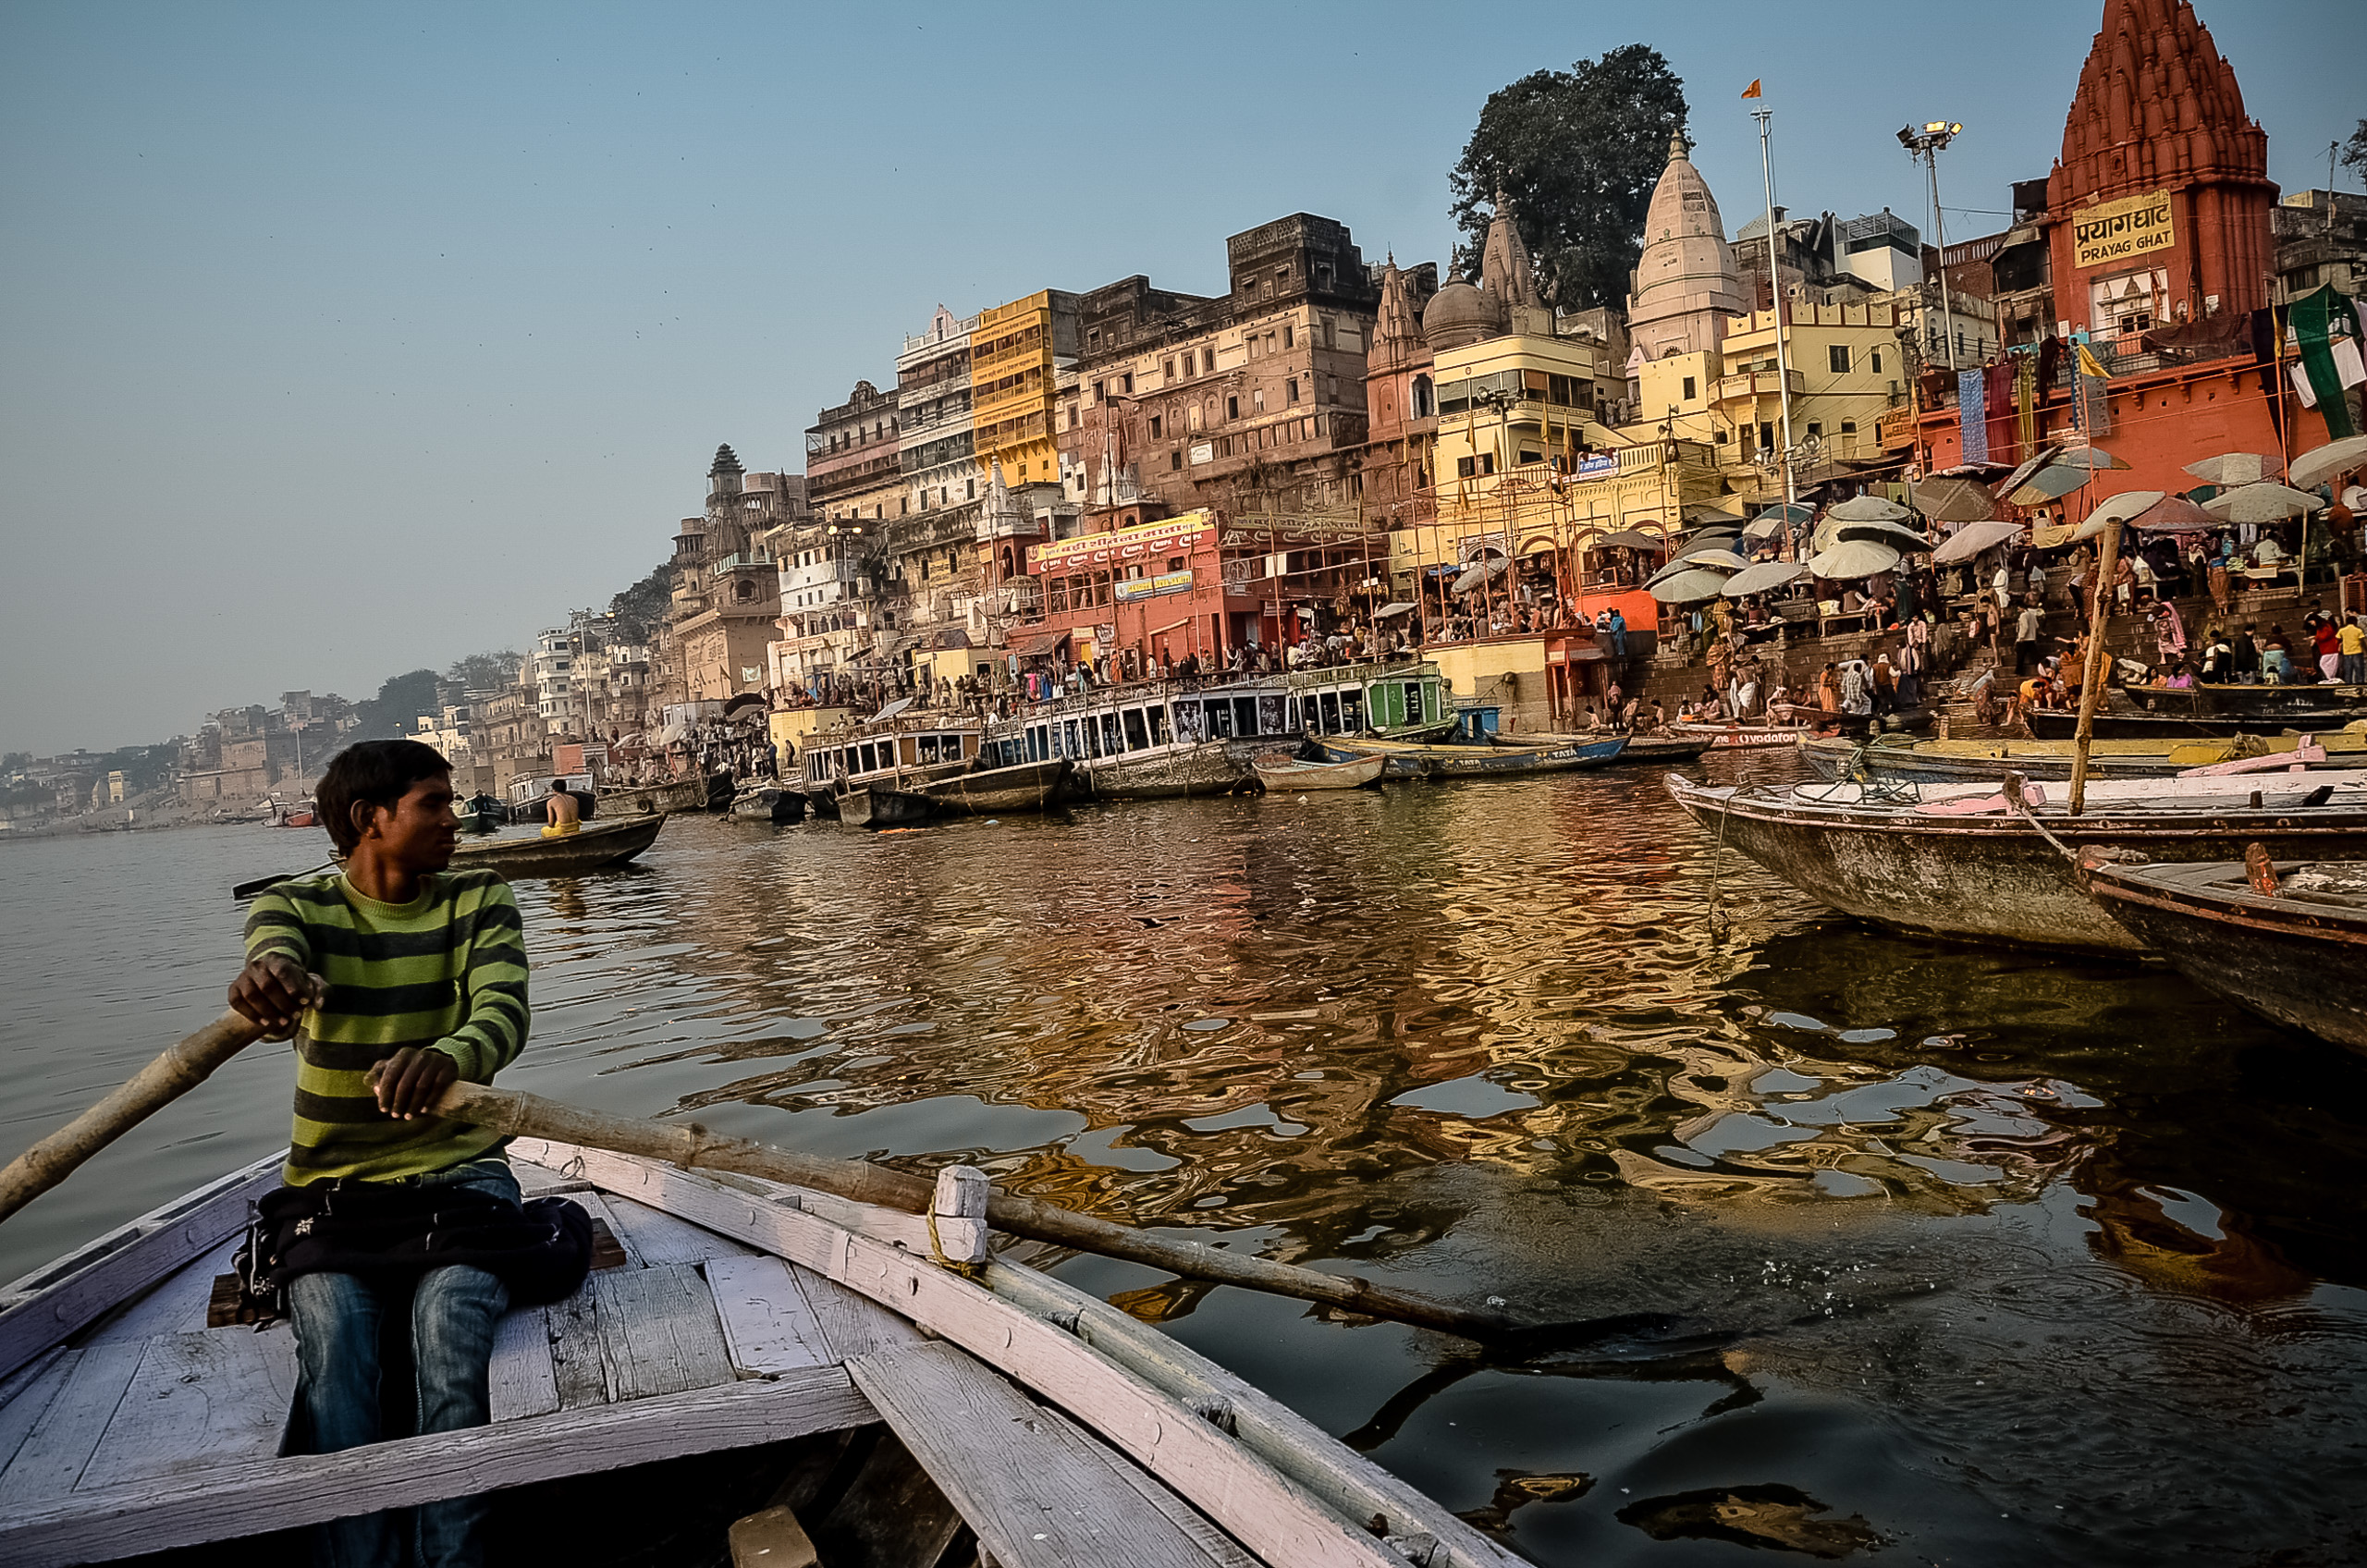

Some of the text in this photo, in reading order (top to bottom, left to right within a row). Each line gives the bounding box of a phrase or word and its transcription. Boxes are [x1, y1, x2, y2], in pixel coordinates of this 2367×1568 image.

[2074, 203, 2170, 248] प्रयाग घाट
[2080, 230, 2171, 263] PRAYAG GHAT
[1390, 690, 1397, 703] 2
[1425, 689, 1433, 701] 2
[1749, 732, 1797, 743] vodafon
[1551, 746, 1577, 758] TATA
